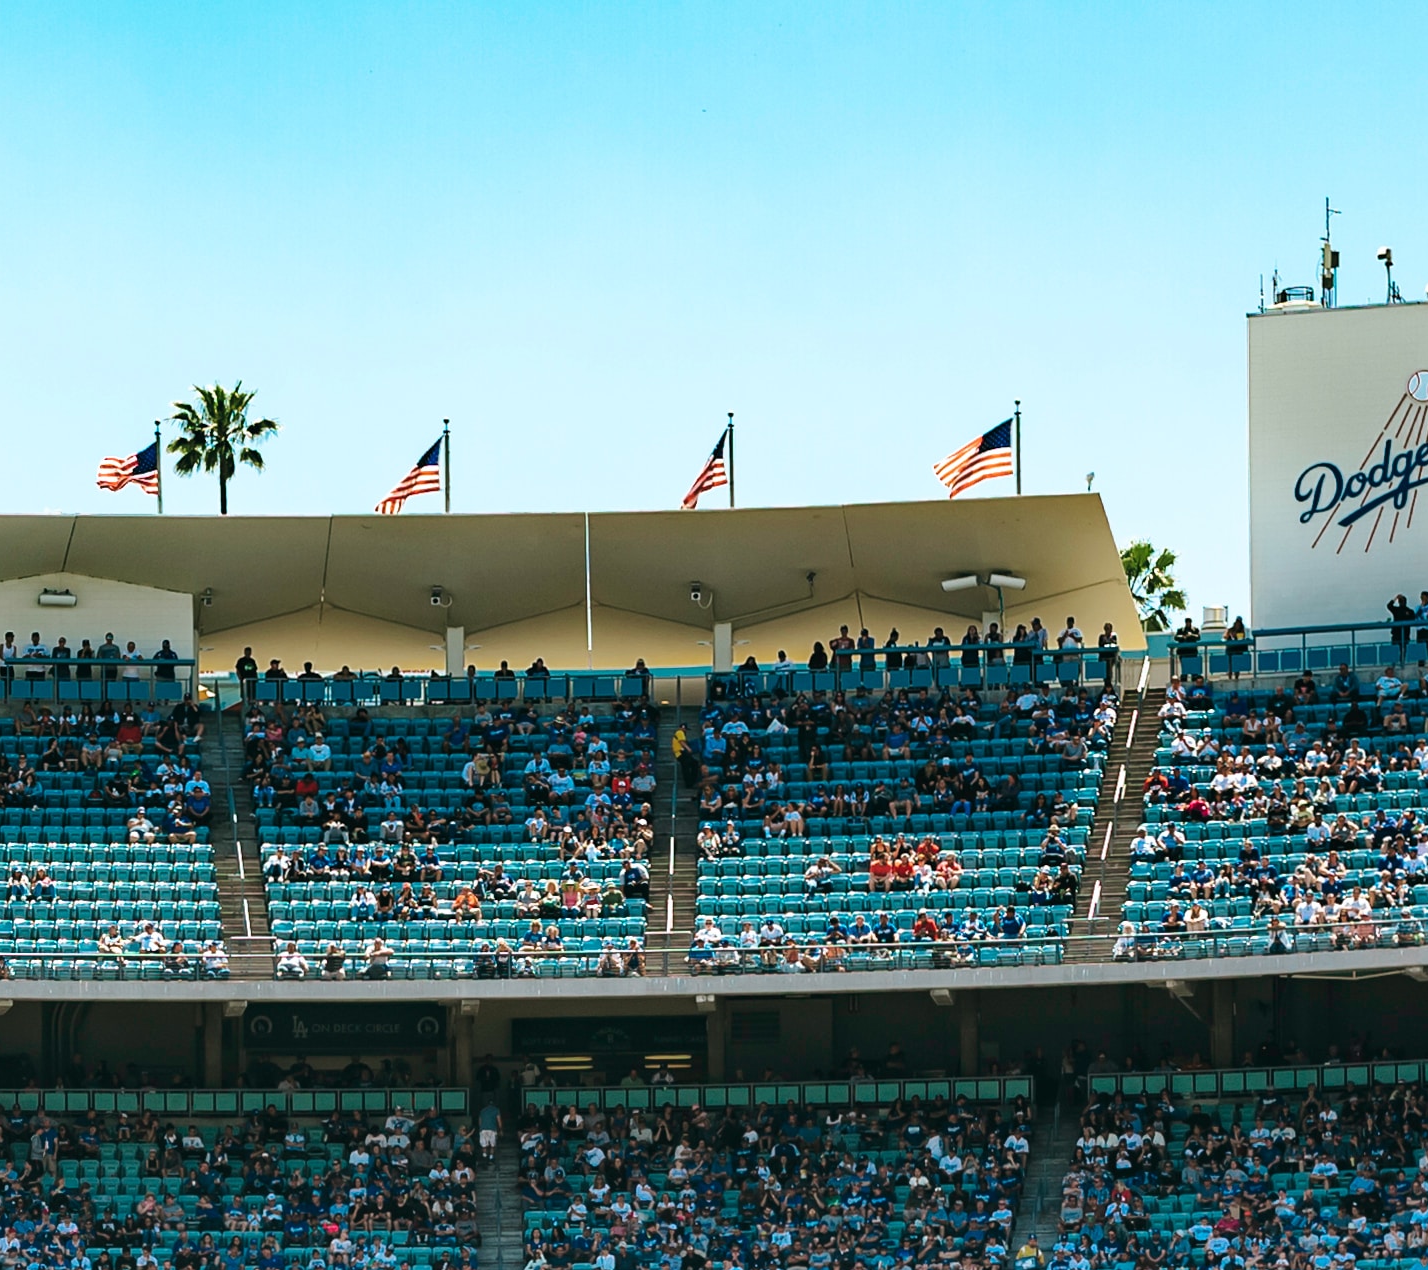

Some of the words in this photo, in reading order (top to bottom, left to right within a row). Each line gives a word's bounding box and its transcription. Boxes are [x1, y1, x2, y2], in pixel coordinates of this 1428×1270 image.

[312, 1023, 332, 1034] ON
[333, 1023, 363, 1034] DECK
[365, 1023, 401, 1034] CIRCLE
